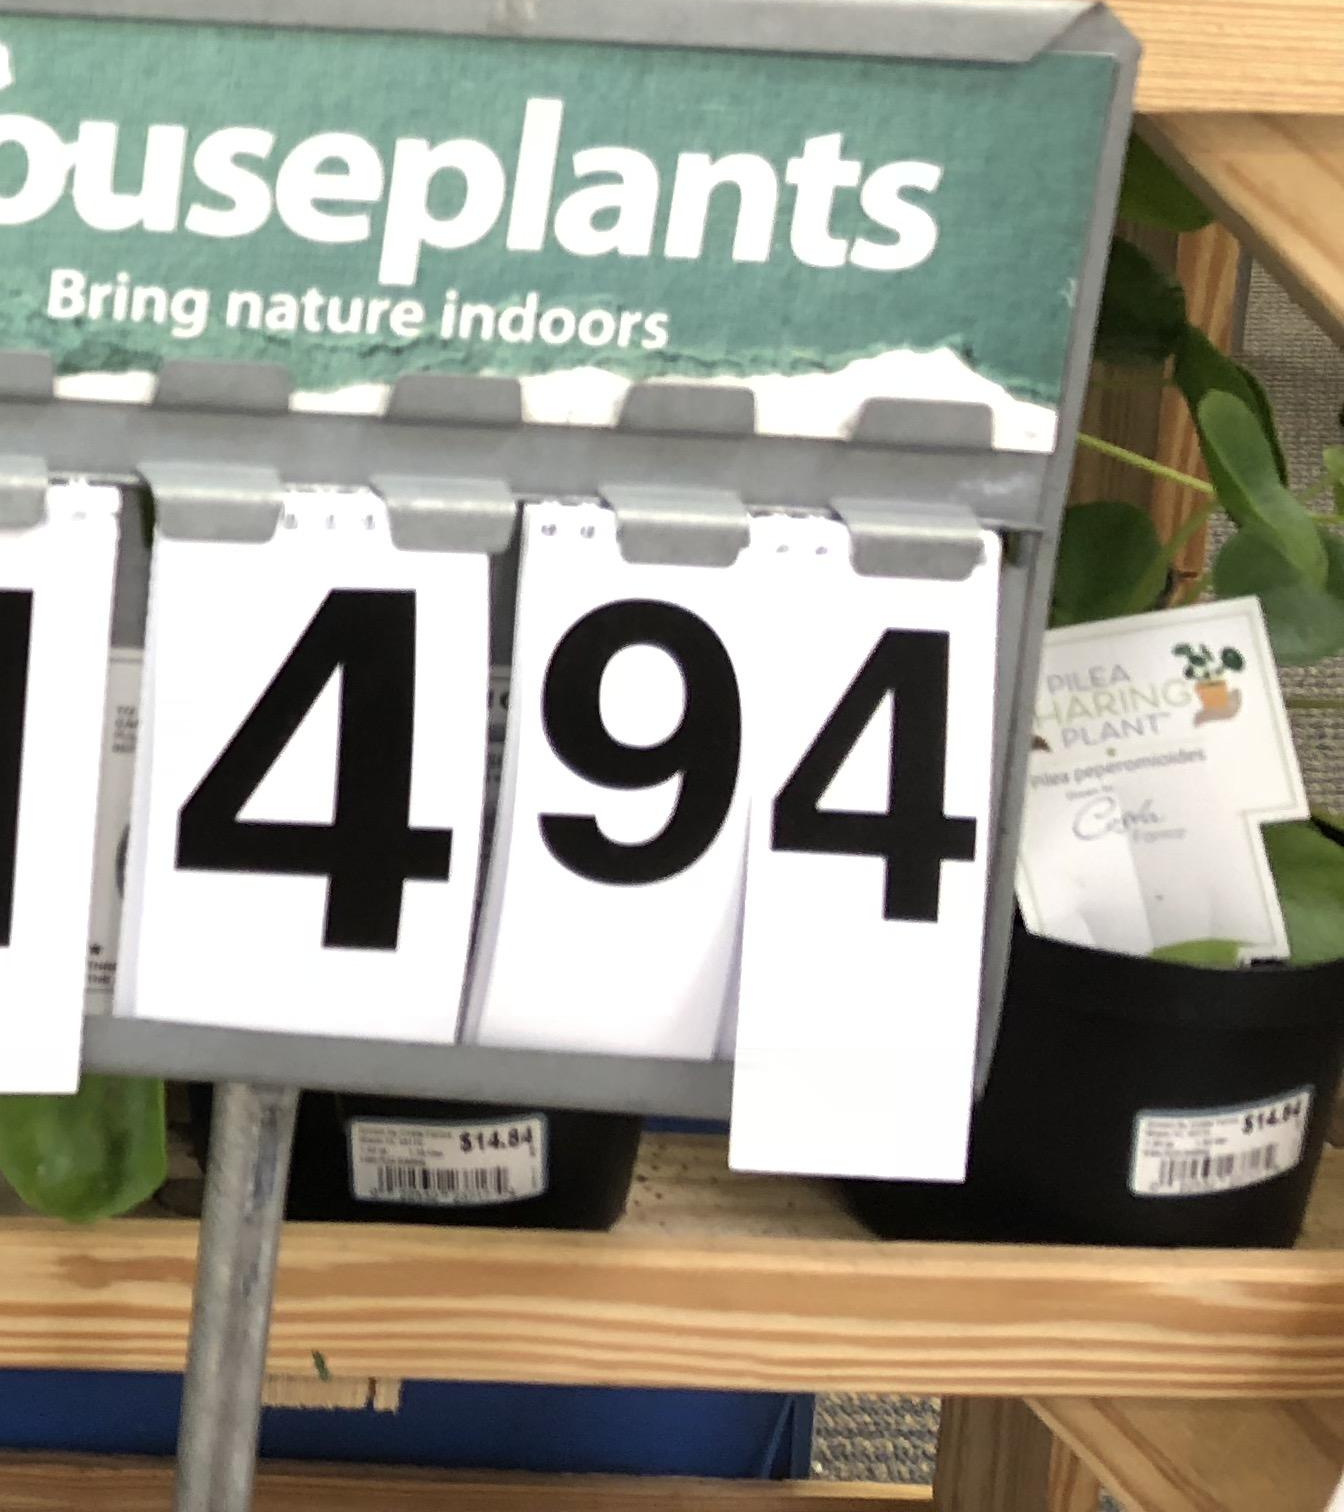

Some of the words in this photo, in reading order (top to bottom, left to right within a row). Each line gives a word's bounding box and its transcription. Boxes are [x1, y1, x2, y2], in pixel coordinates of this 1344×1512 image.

[46, 268, 208, 338] Bring
[225, 286, 424, 338] nature
[440, 290, 669, 351] indoors
[1033, 677, 1192, 728] HARING
[1047, 663, 1131, 694] PILEA
